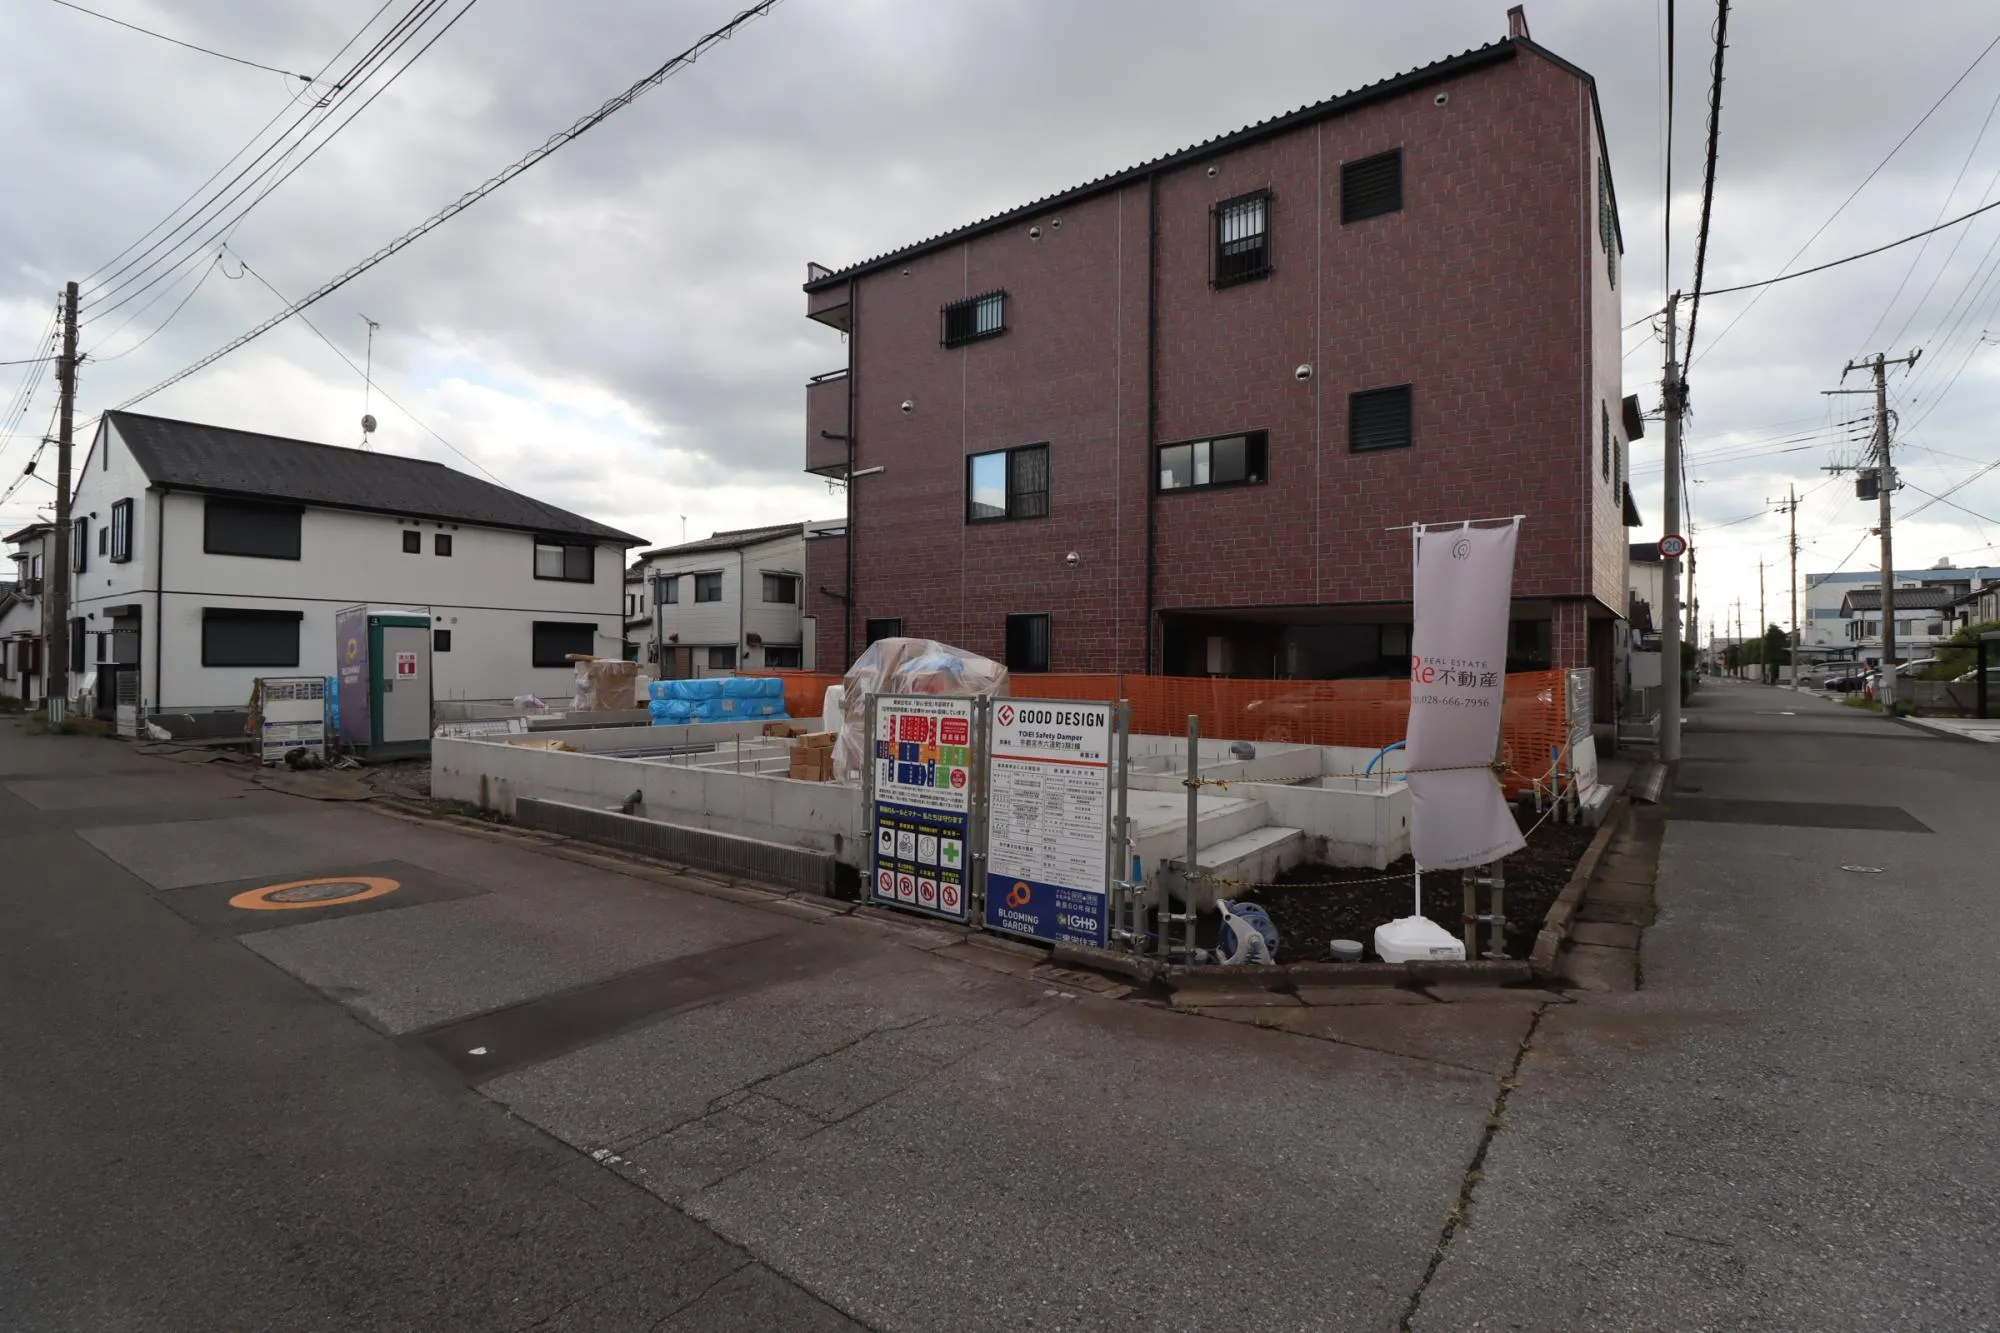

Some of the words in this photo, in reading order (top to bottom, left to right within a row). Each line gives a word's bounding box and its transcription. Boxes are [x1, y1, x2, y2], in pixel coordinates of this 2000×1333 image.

[1664, 541, 1680, 552] 20
[1451, 659, 1488, 669] ESTATE
[1019, 710, 1052, 725] GOOD
[1056, 712, 1104, 727] DESIGN
[1018, 730, 1035, 738] TOEI
[1036, 732, 1055, 741] Safety
[1057, 733, 1082, 741] Damper
[998, 908, 1039, 925] BLOOMING
[1002, 919, 1035, 934] GARDEN
